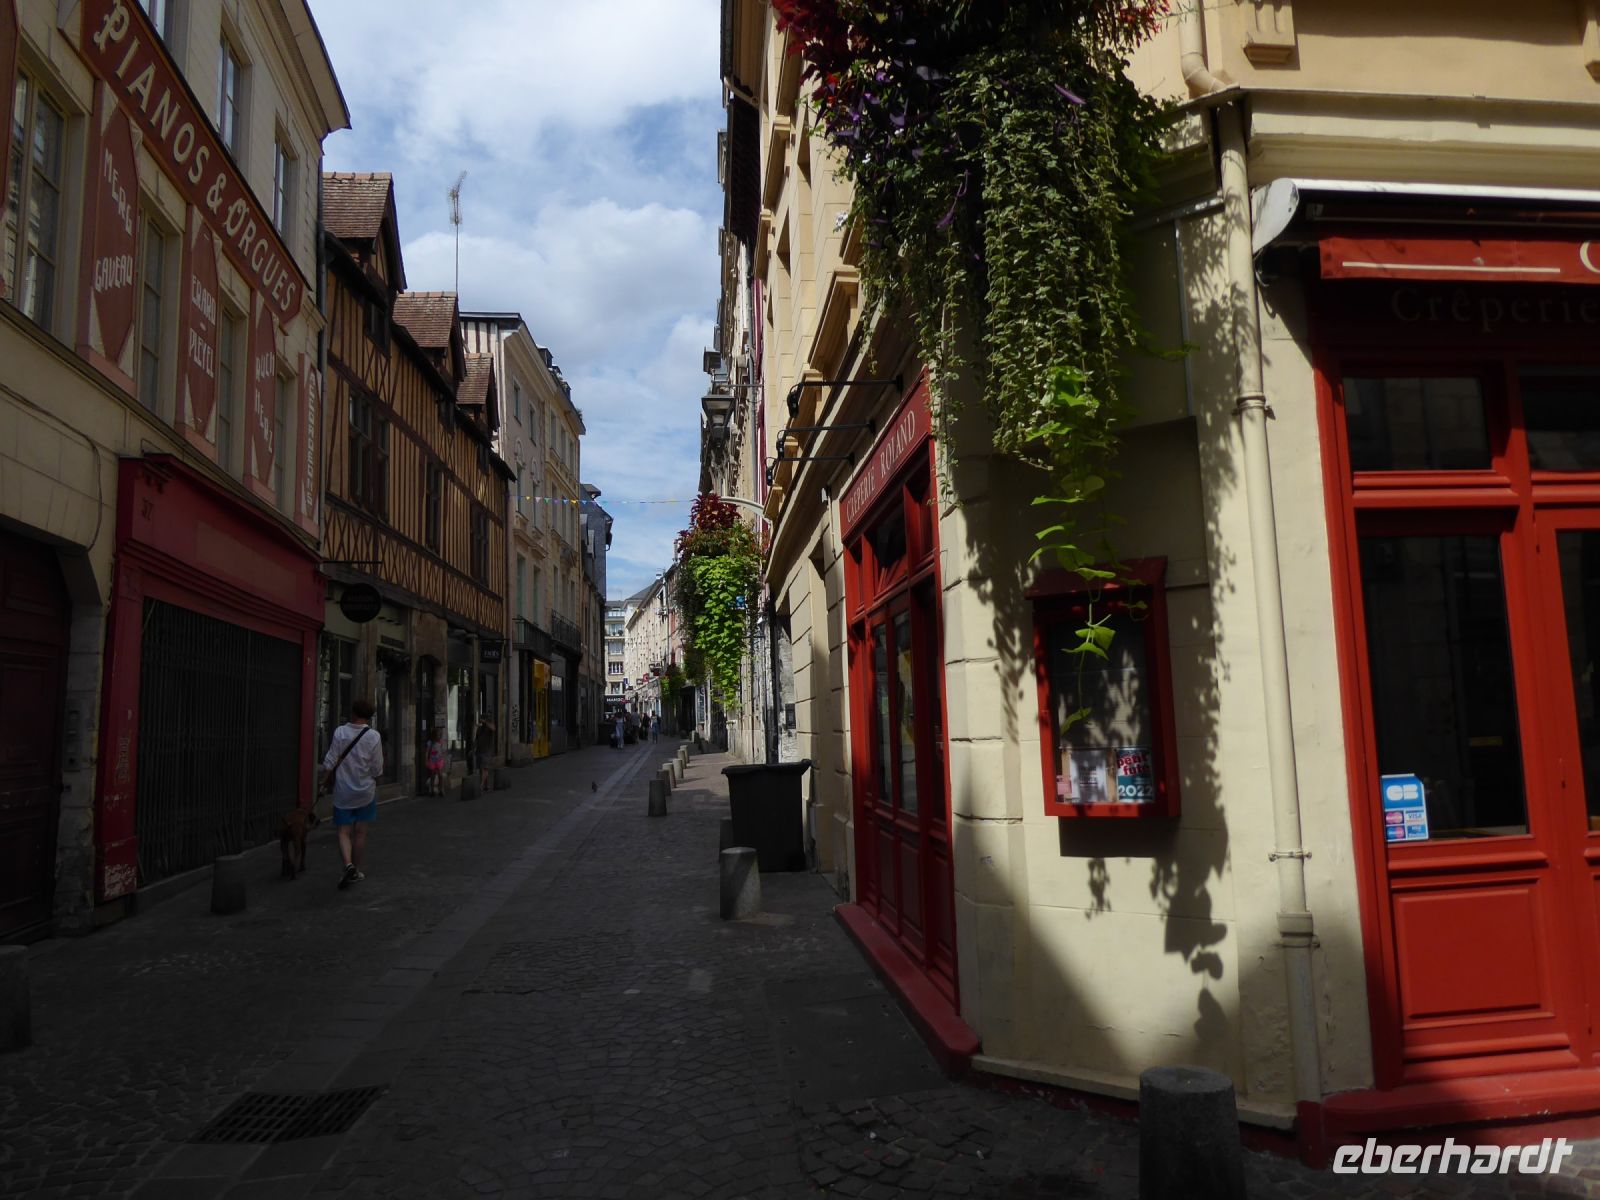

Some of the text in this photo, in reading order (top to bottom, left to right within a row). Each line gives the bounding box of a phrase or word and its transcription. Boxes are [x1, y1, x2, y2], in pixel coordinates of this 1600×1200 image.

[93, 0, 296, 312] PIANOS & ORGUES
[95, 254, 133, 292] GAVEAU
[1391, 288, 1600, 332] Crêperie
[188, 327, 215, 379] PLEYEL
[880, 410, 916, 478] ROLAND
[1118, 785, 1153, 797] 2022
